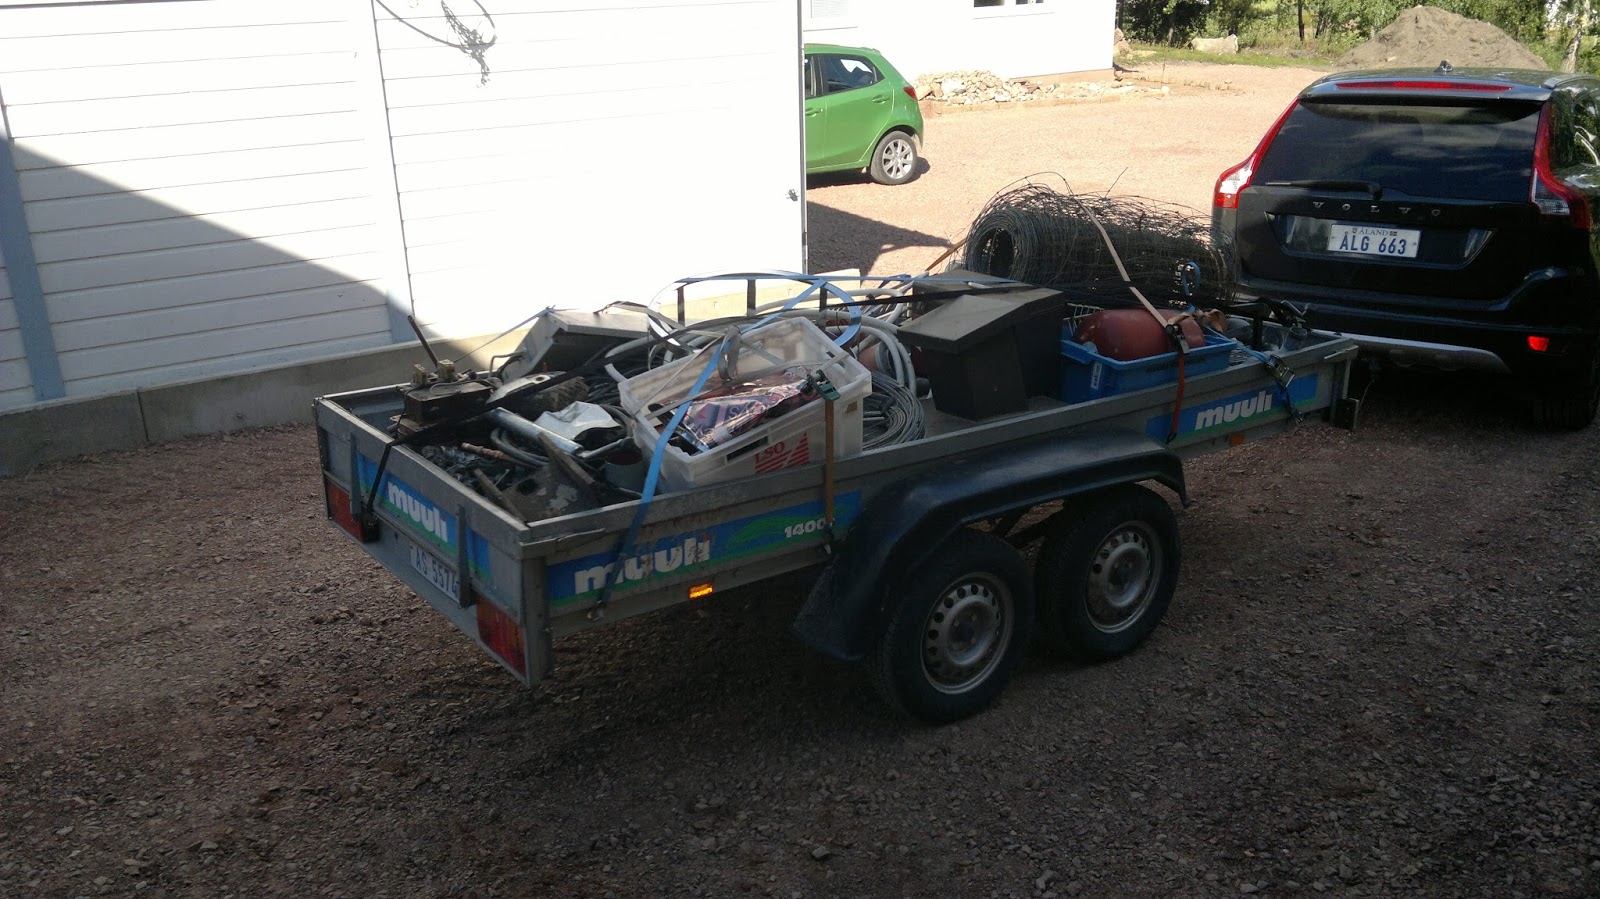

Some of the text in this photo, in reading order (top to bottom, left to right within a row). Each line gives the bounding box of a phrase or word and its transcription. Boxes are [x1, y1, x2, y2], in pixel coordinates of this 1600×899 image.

[1312, 201, 1441, 217] VOLVO
[1339, 230, 1408, 255] ÅLG 663
[1359, 226, 1389, 237] ÅLAND
[1195, 389, 1273, 430] muuli
[754, 441, 786, 464] LSO
[388, 481, 448, 543] muuli
[574, 534, 711, 595] muuli
